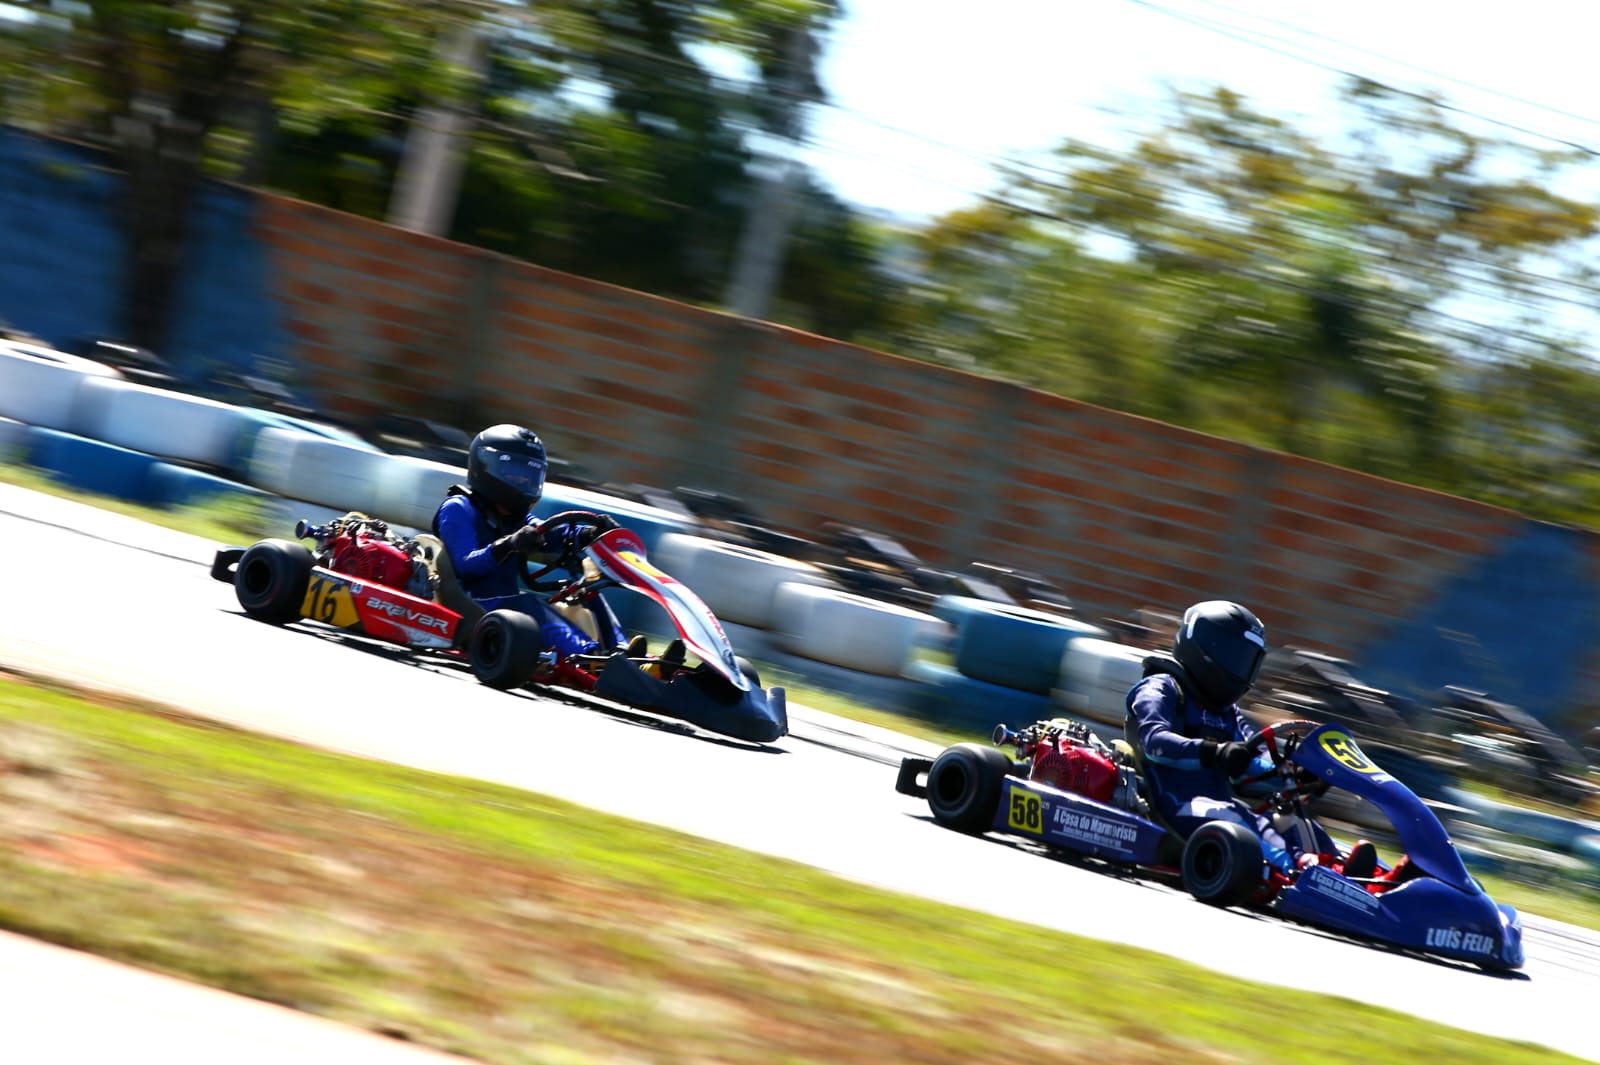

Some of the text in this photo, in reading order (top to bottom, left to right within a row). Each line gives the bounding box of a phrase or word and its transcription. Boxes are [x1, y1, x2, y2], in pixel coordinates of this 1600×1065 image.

[310, 579, 341, 624] 16
[1012, 794, 1040, 829] 58
[1053, 808, 1061, 823] A
[1060, 810, 1079, 828] Casa
[1079, 815, 1090, 830] do
[1090, 817, 1137, 842] Marmorista
[1425, 926, 1463, 951] LUÍS
